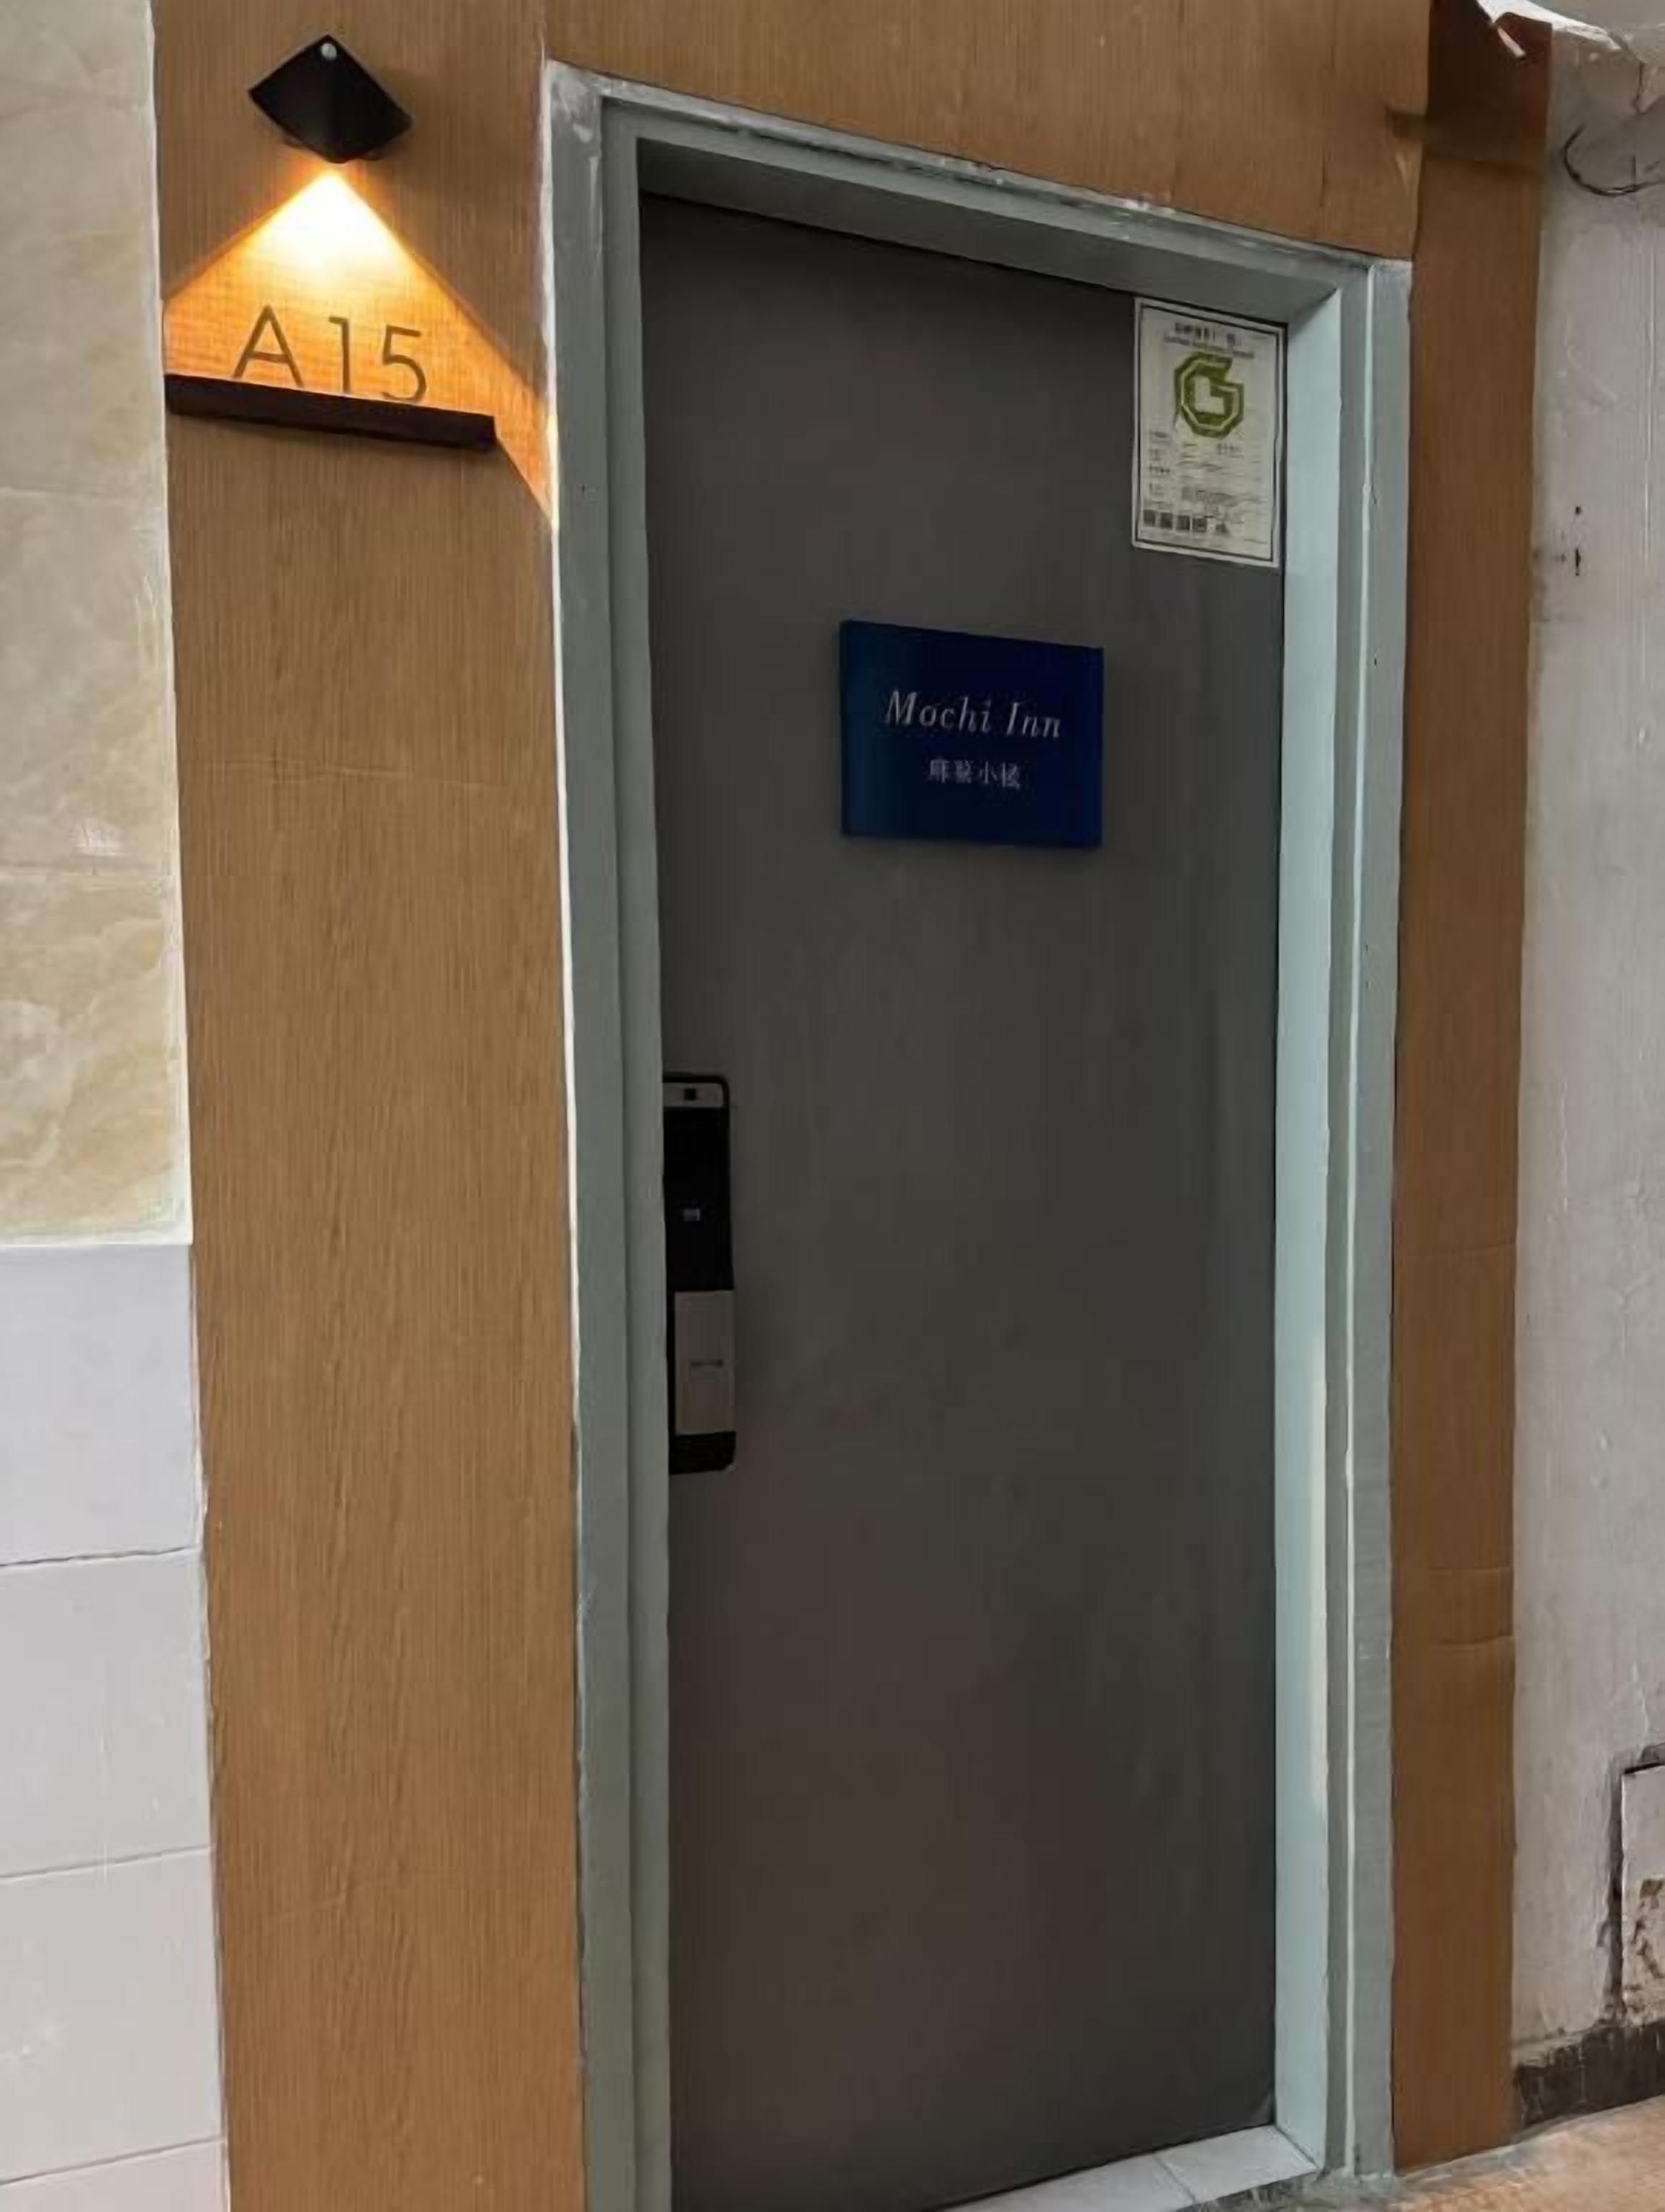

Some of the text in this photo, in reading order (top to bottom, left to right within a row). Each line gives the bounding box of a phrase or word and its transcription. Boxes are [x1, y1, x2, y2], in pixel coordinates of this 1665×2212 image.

[233, 305, 426, 402] A15
[886, 690, 1061, 738] Mochi Inn
